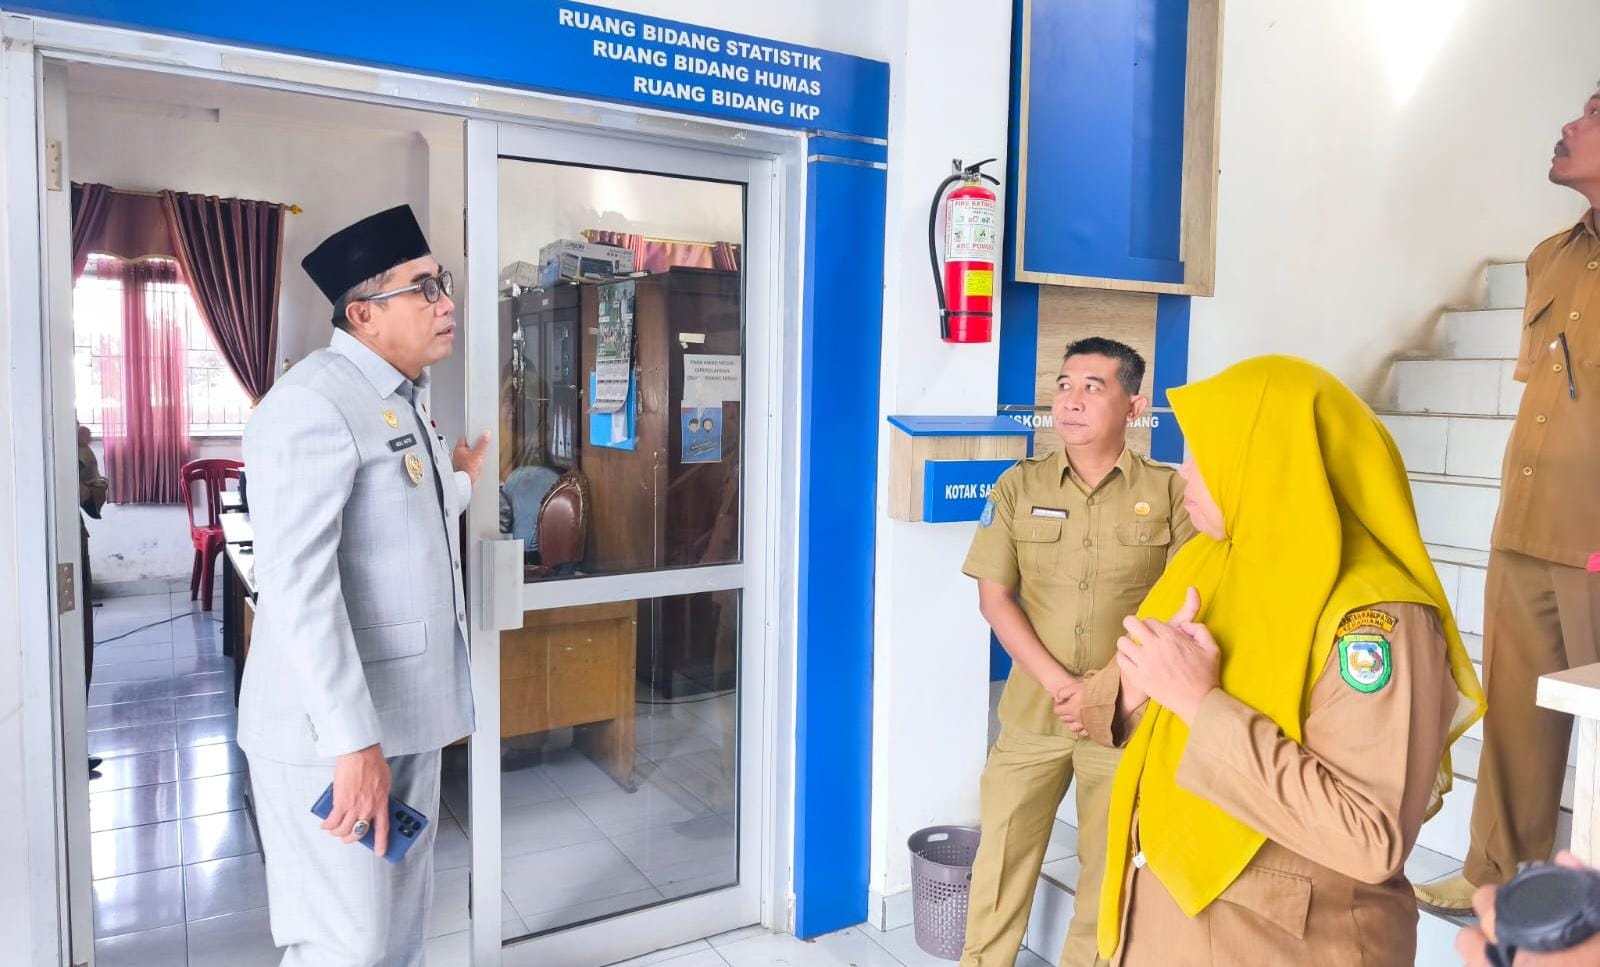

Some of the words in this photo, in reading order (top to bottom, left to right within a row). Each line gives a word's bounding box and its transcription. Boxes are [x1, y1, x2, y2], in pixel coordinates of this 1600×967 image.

[559, 8, 636, 37] RUANG
[643, 24, 721, 53] BIDANG
[726, 40, 822, 71] STATISTIK
[593, 39, 667, 68] RUANG
[674, 54, 749, 83] BIDANG
[755, 70, 821, 96] HUMAS
[633, 76, 705, 103] RUANG
[712, 89, 784, 116] BIDANG
[790, 102, 820, 121] IKP
[945, 484, 978, 500] KOTAK
